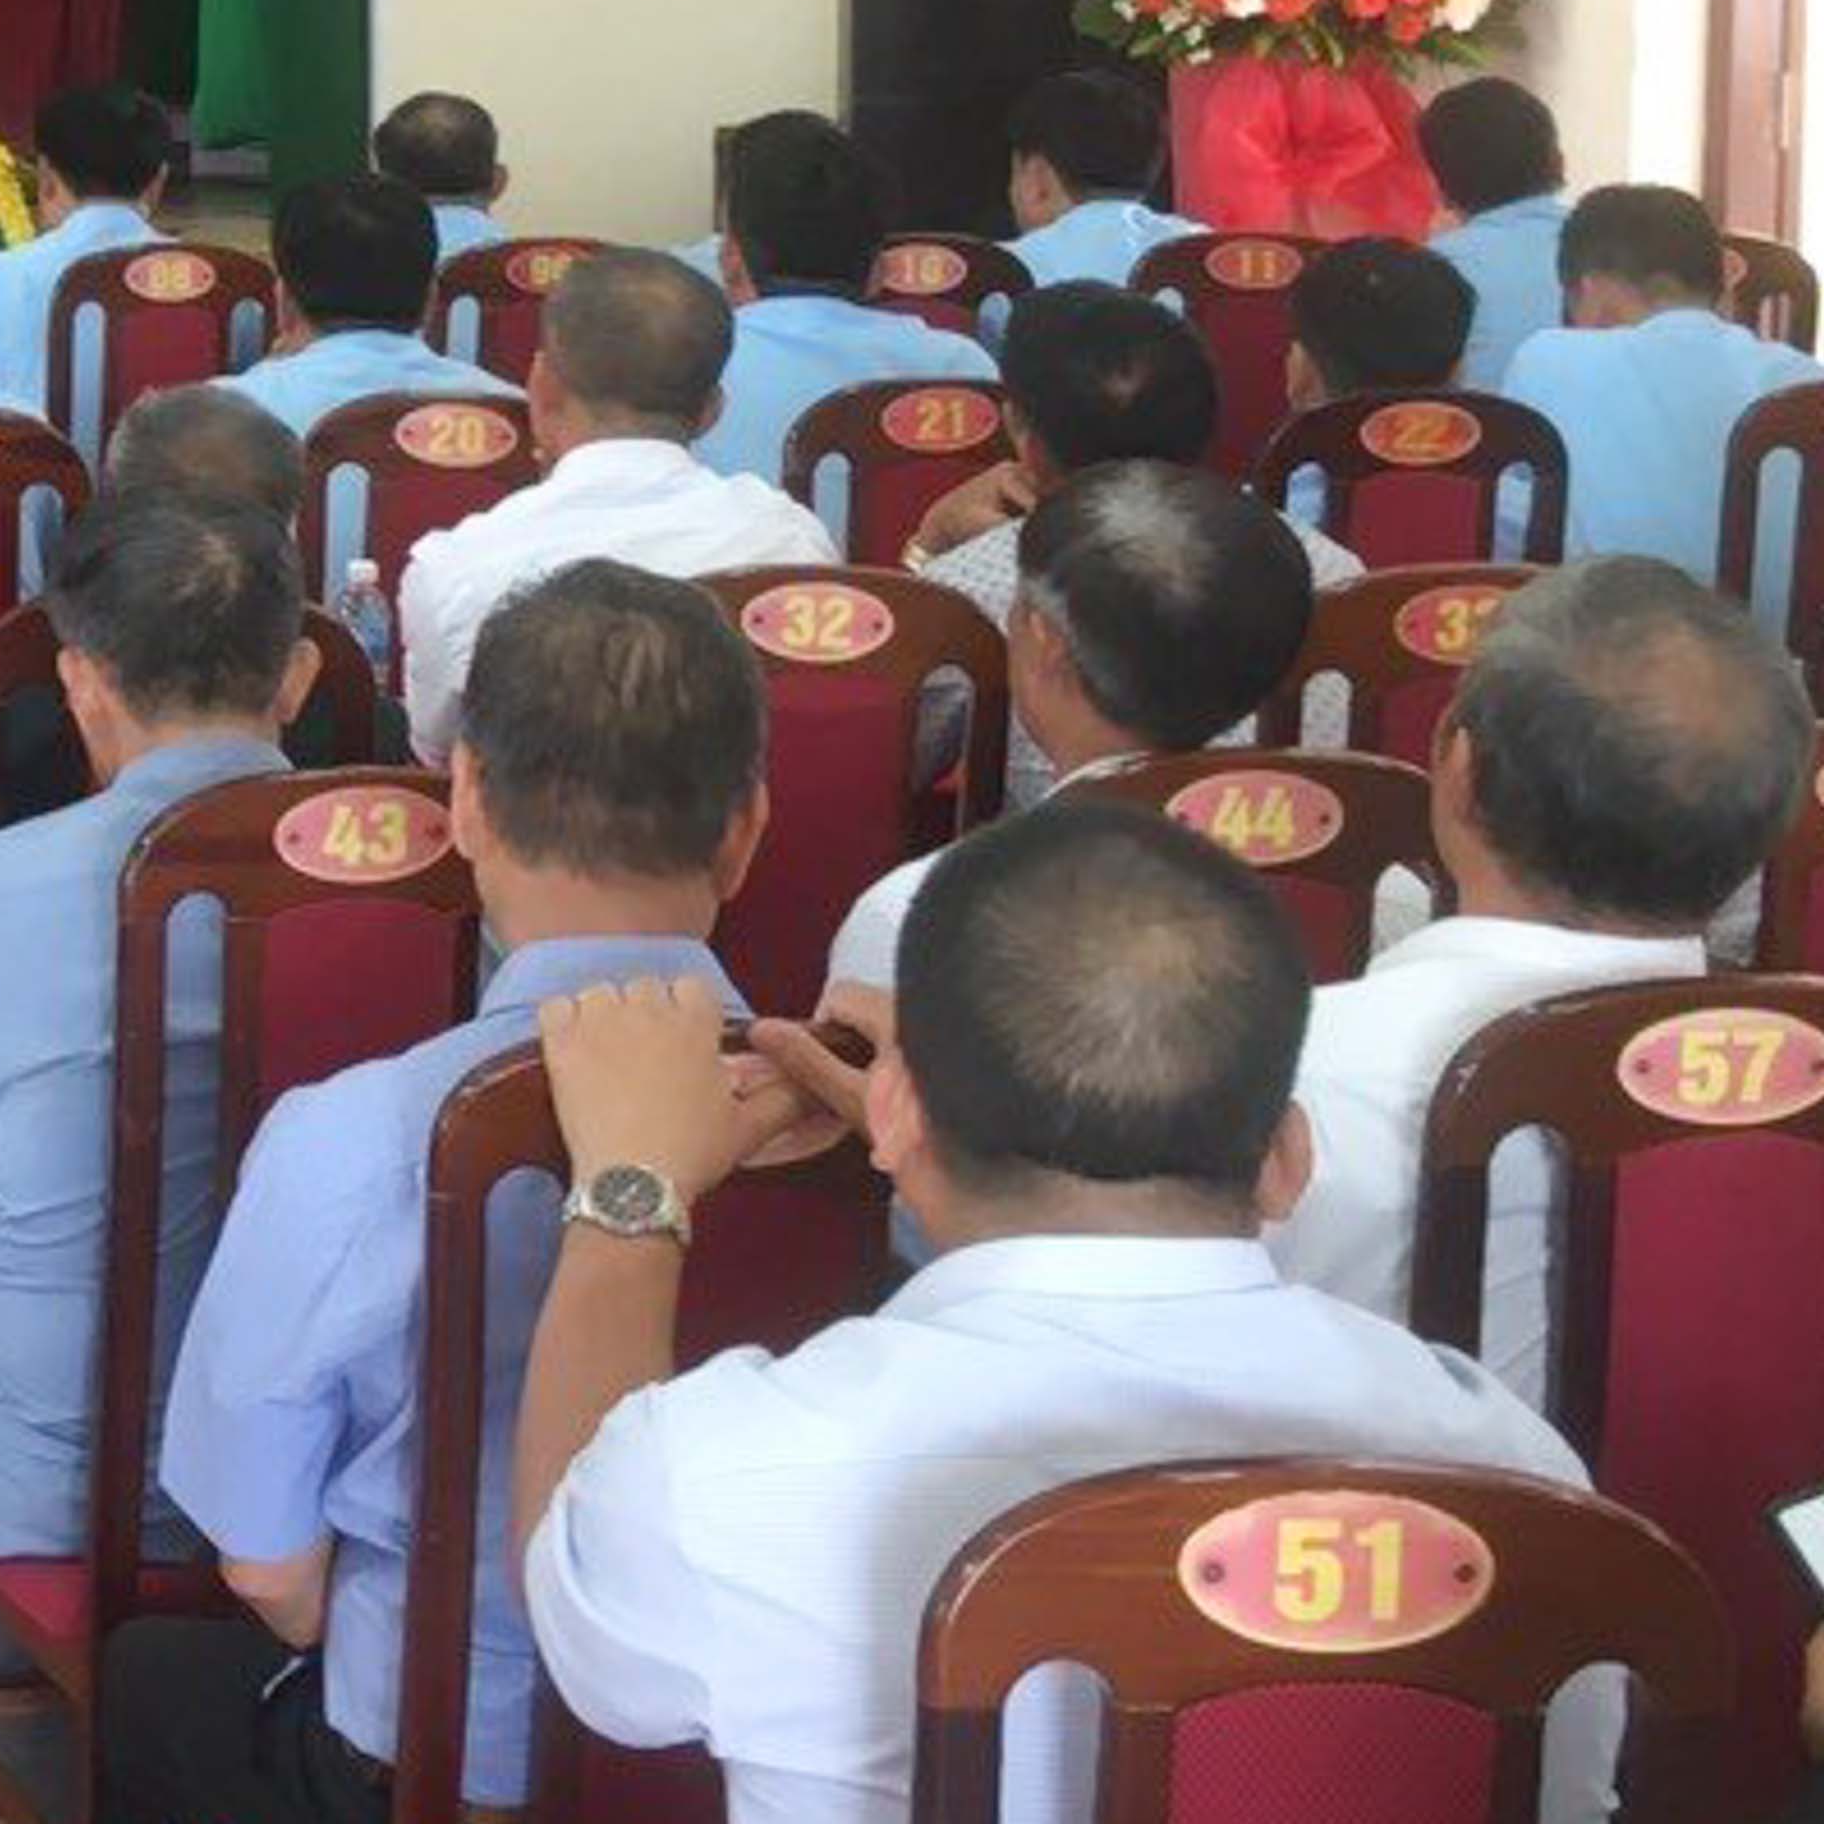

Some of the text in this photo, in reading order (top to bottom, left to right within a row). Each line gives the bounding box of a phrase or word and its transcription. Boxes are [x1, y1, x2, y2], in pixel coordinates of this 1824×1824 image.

[429, 416, 484, 456] 20
[917, 402, 966, 439] 21
[781, 595, 853, 648] 32
[321, 802, 409, 866] 43
[1212, 788, 1295, 846] 44
[1677, 1028, 1785, 1108] 57
[1271, 1518, 1401, 1624] 51
